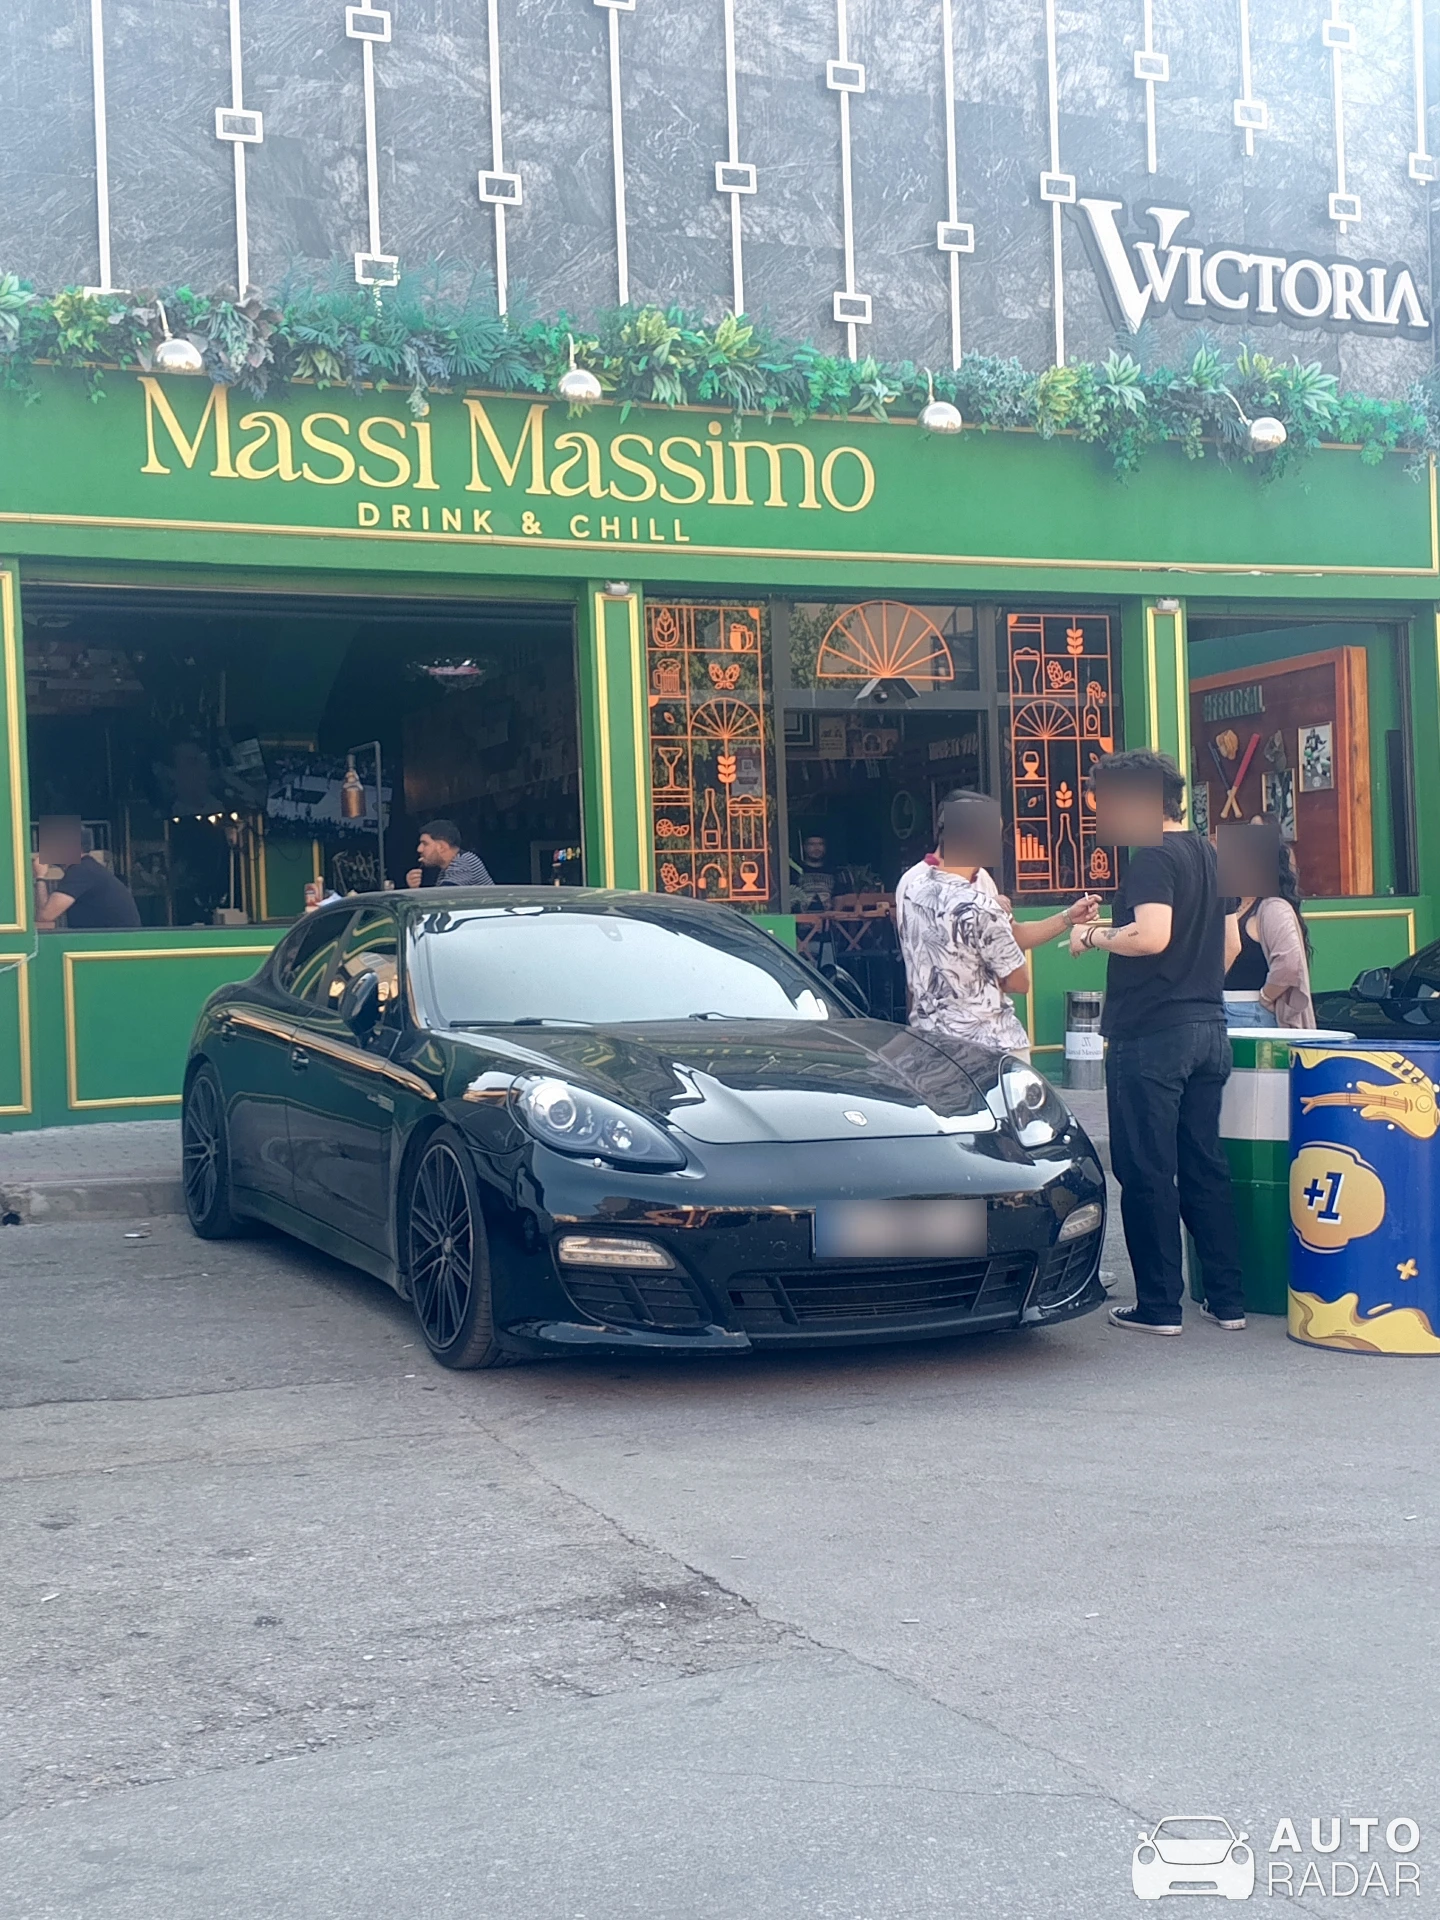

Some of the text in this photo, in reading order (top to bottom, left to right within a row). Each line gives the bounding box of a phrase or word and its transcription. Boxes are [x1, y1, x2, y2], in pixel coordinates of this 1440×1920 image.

[137, 376, 876, 512] Massi Massimo
[357, 501, 690, 542] DRINK & CHILL
[1303, 1172, 1344, 1224] +1
